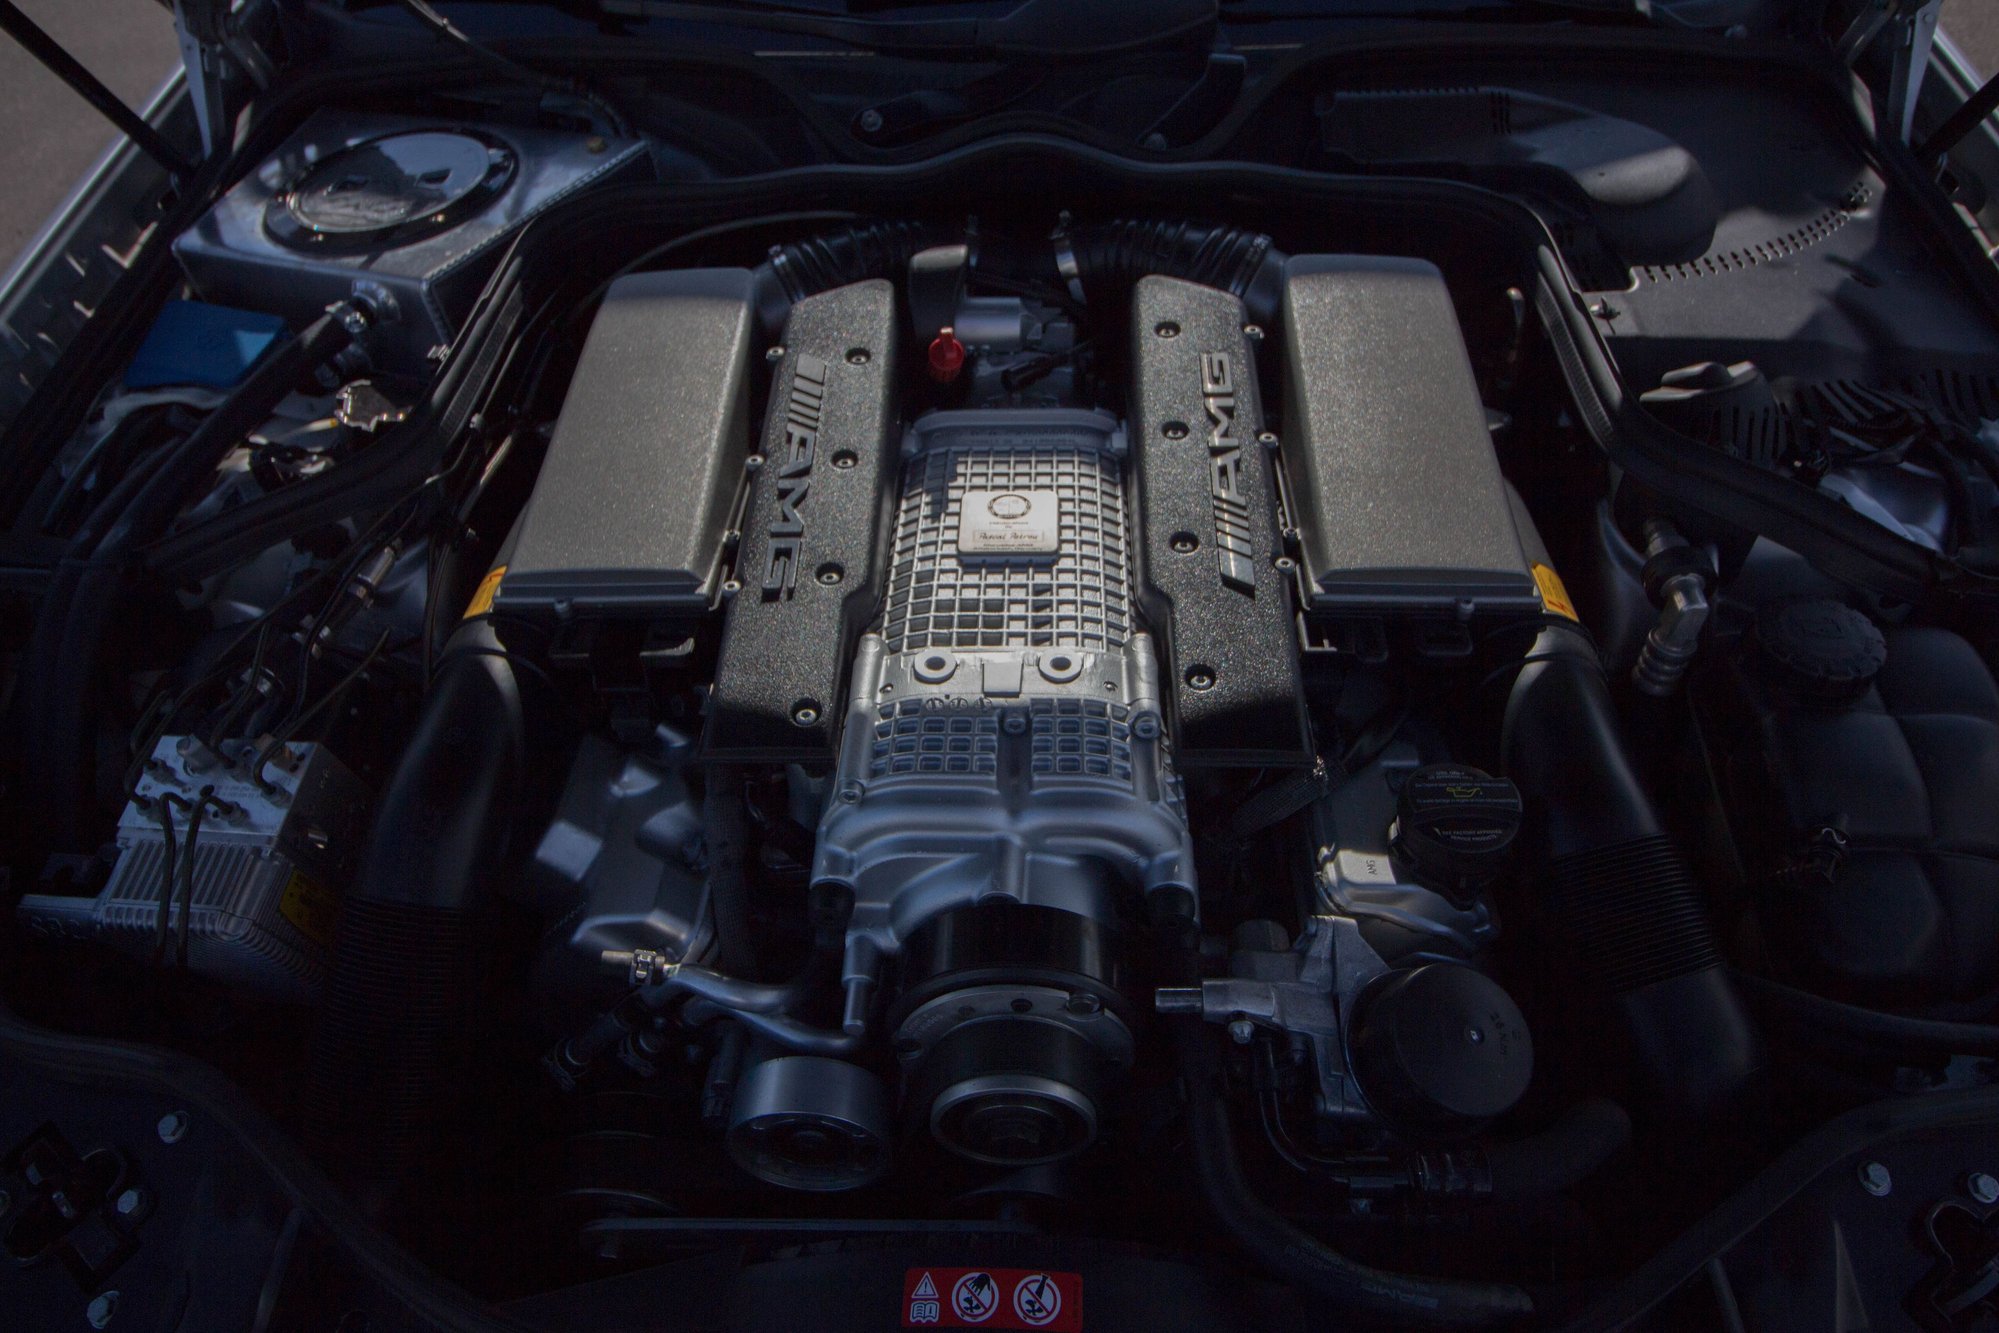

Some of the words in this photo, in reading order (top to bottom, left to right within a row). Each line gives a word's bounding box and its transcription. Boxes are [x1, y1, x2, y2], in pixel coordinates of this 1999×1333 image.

[760, 421, 816, 598] AMG
[1200, 351, 1247, 511] AMG
[1366, 860, 1378, 876] AMG
